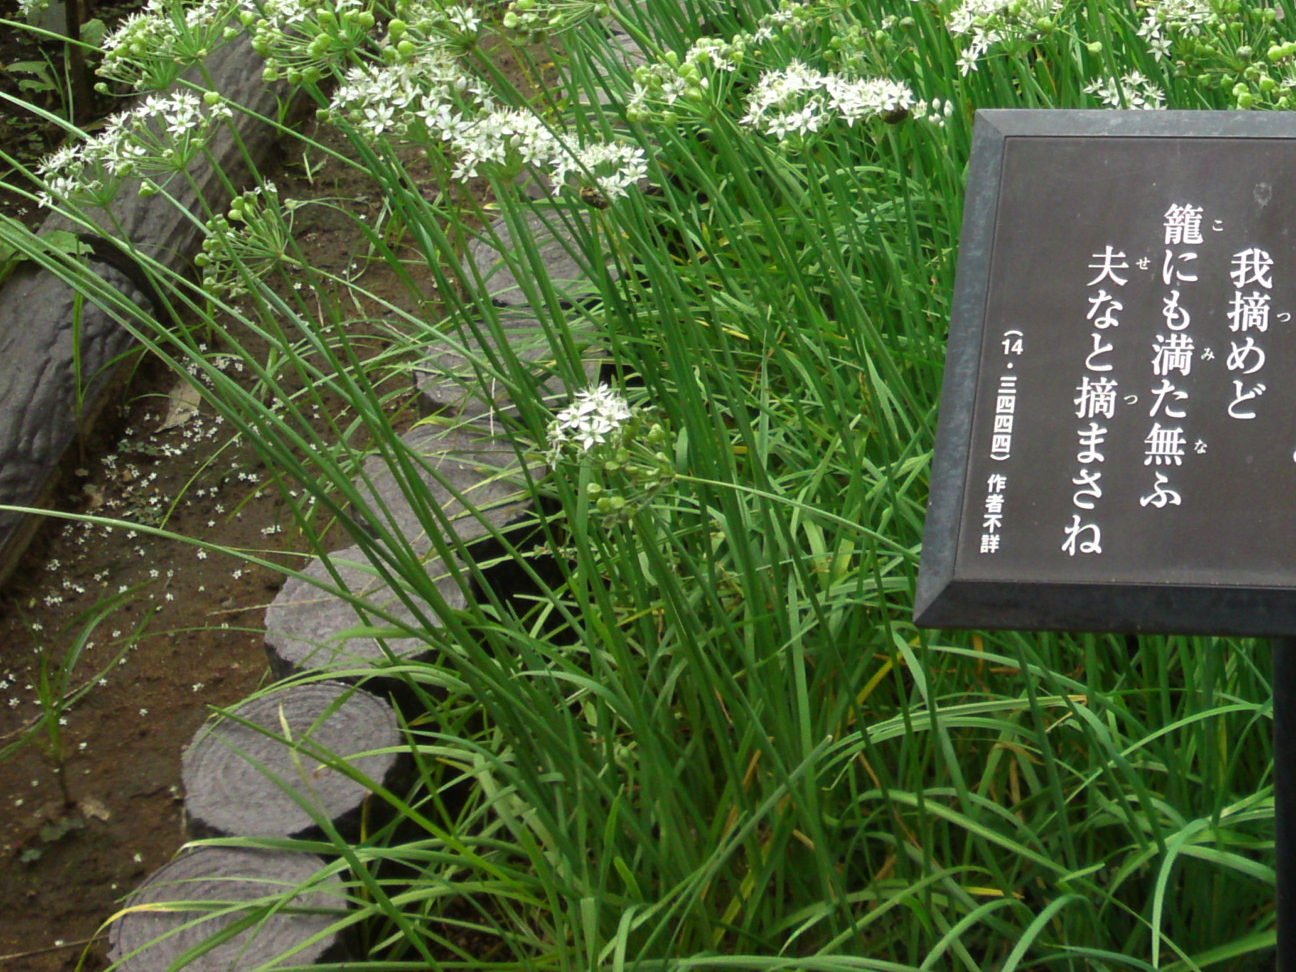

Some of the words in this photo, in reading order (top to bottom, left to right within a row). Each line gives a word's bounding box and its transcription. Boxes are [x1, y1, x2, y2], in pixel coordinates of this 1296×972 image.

[1061, 245, 1130, 557] 夫なと摘まさね
[1140, 201, 1205, 509] 籠にも満た無ふ
[1226, 247, 1275, 420] 我摘めど
[980, 474, 1008, 554] 作者不詳
